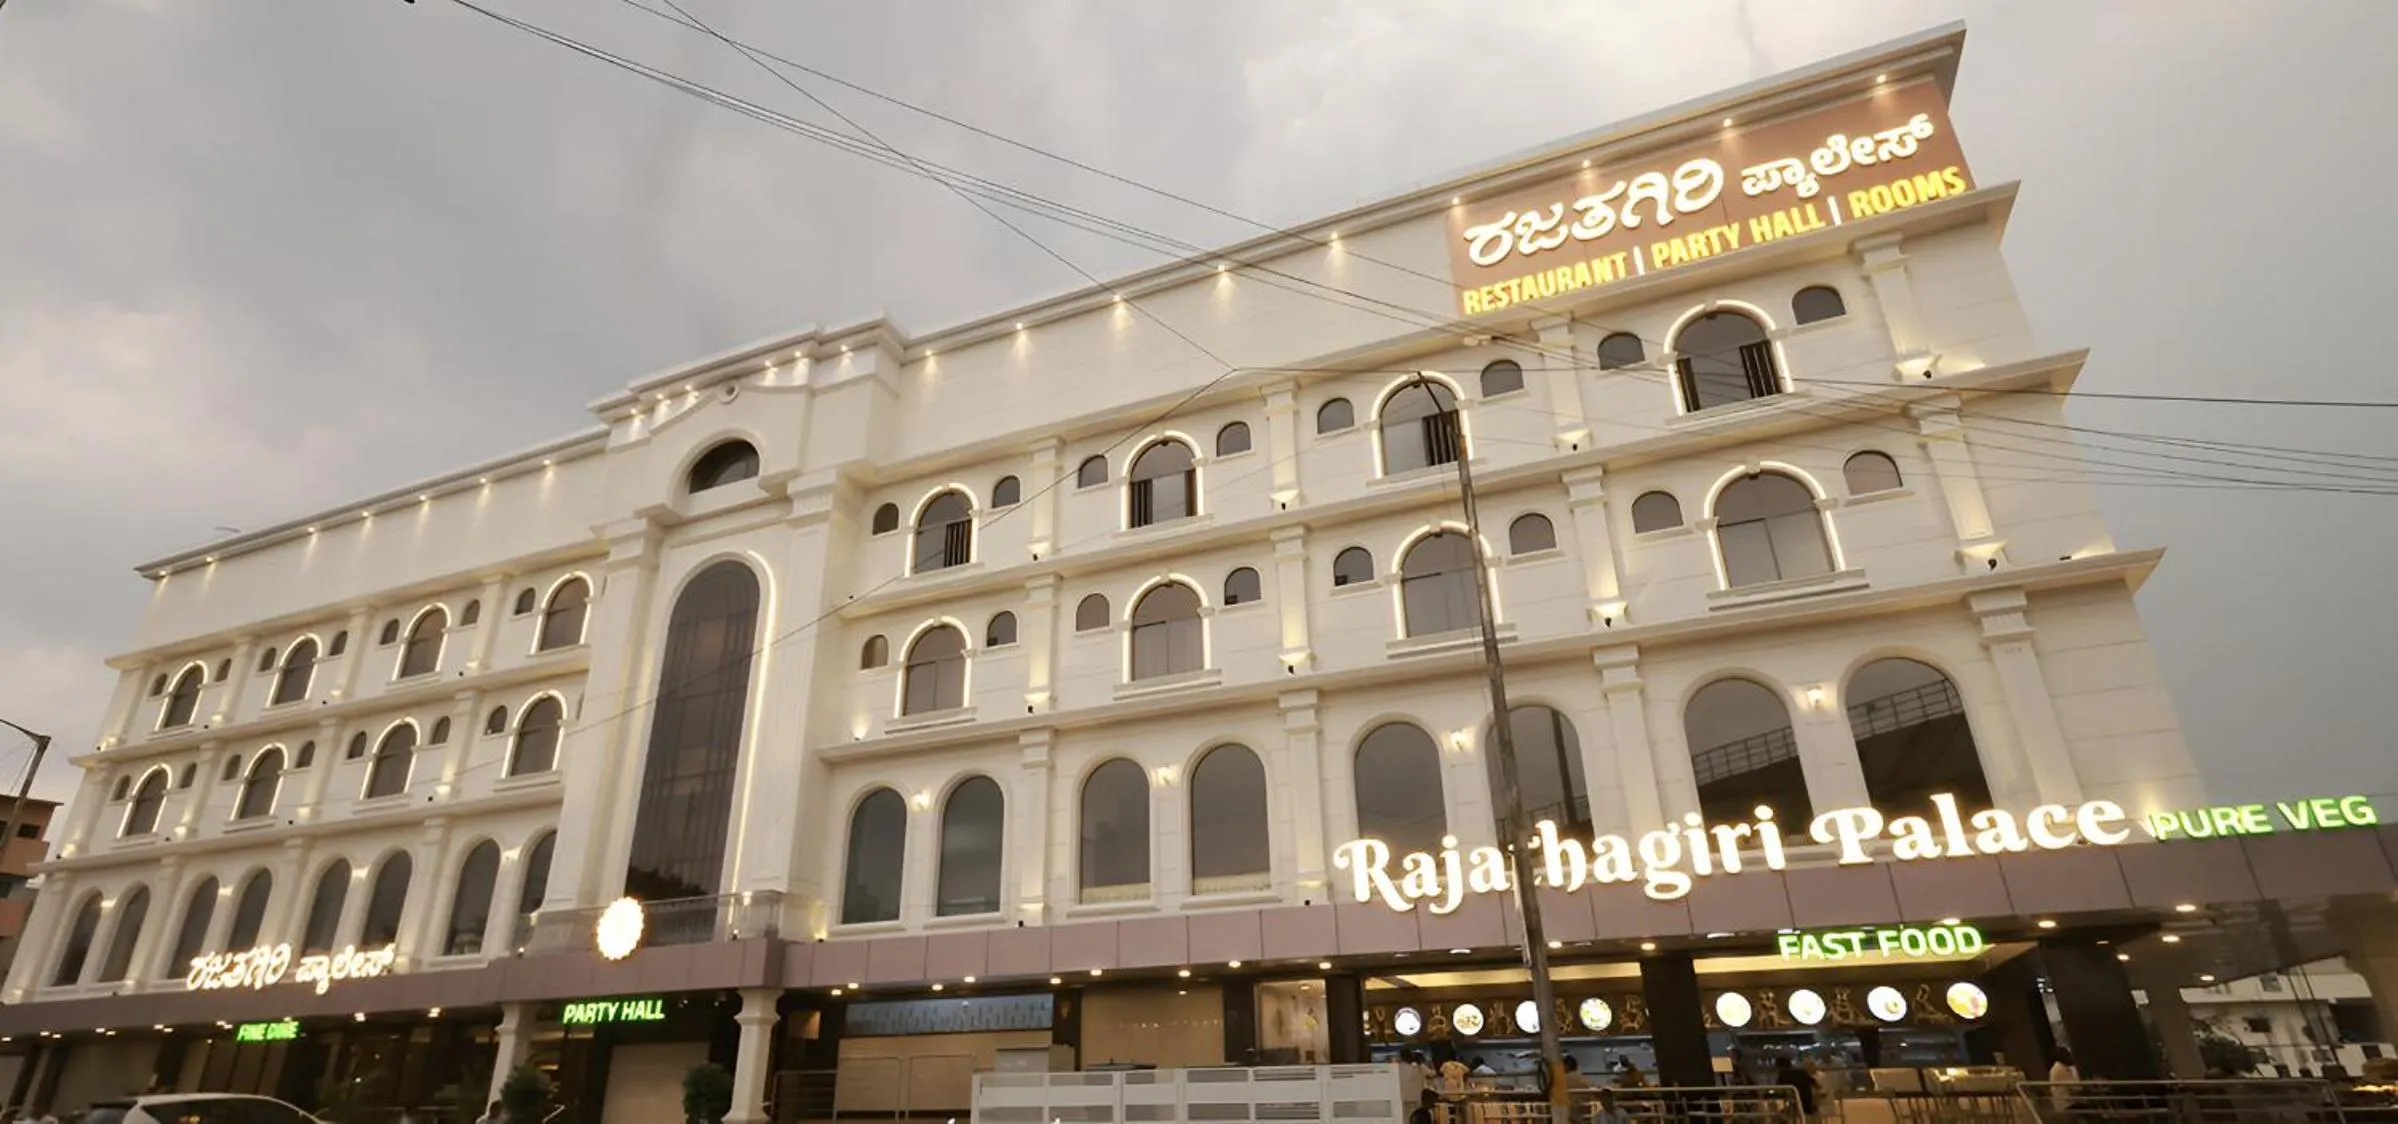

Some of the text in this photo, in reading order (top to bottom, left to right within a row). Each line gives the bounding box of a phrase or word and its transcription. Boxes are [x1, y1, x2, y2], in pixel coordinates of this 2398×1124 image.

[1463, 113, 1934, 267] ರಜತಗಿರಿ ಪ್ಯಾಲೇಸ್
[1462, 251, 1628, 315] RESTAURANT
[1651, 223, 1740, 269] PARTY
[1749, 203, 1826, 244] HALL
[1848, 166, 1967, 219] ROOMS
[1333, 793, 2131, 914] Rajahagiri Palace
[2150, 795, 2378, 841] PURE VEG
[1778, 925, 1984, 961] FAST FOOD
[563, 1000, 665, 1024] PARTY HALL
